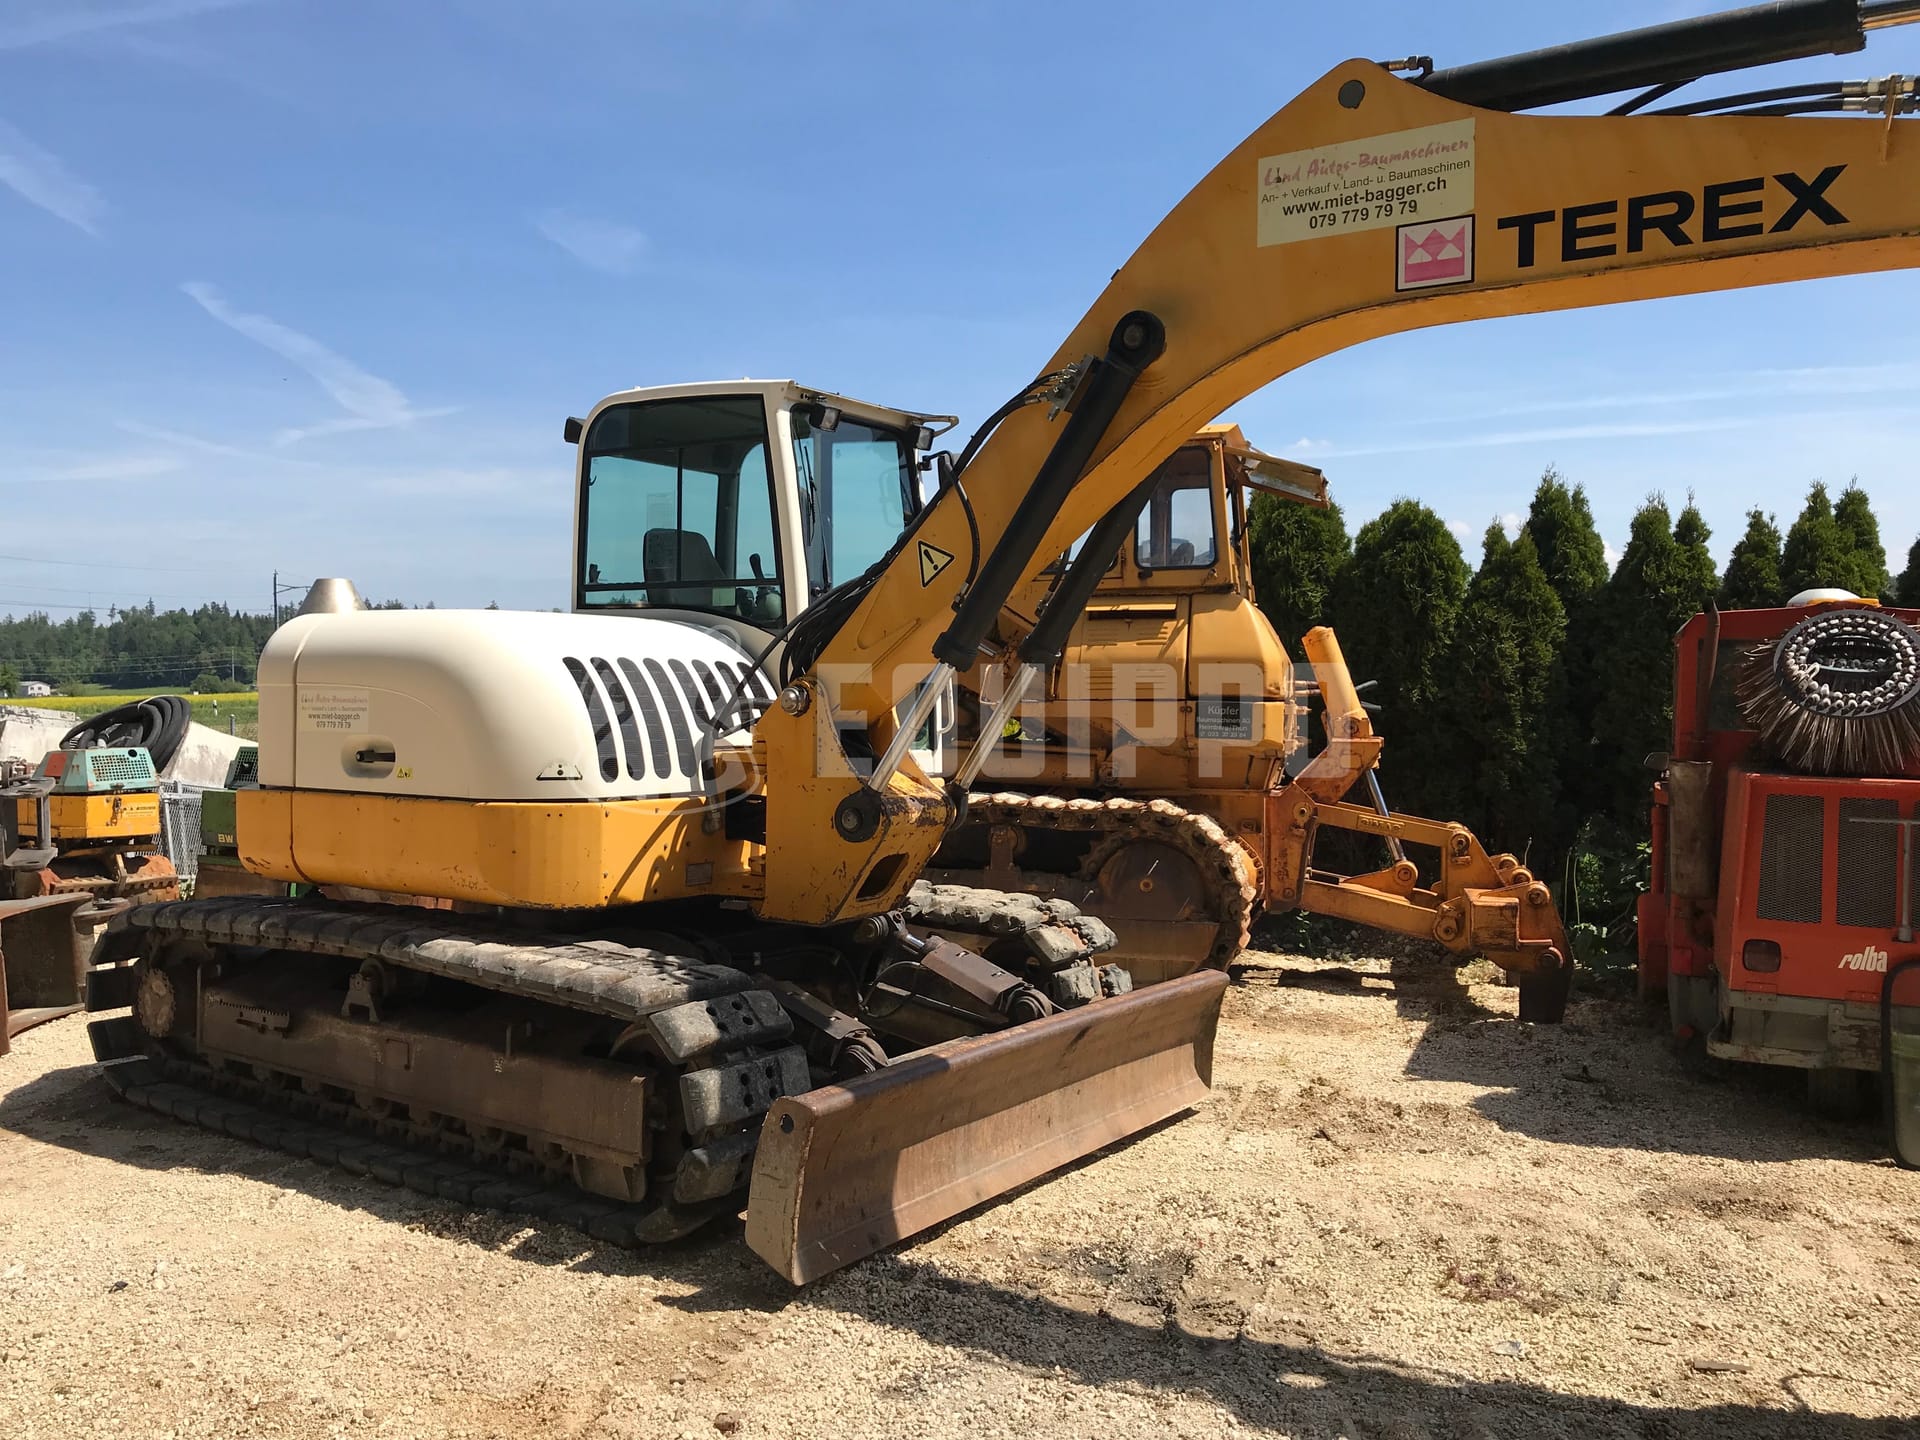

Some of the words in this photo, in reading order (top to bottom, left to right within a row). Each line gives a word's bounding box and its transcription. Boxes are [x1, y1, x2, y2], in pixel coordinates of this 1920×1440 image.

[1262, 194, 1279, 204] An-
[1292, 182, 1330, 199] Verkauf
[1343, 176, 1373, 190] Land-
[1377, 175, 1386, 184] u.
[1389, 160, 1470, 182] Baumaschinen
[1283, 177, 1447, 216] www.miet-bagger.ch
[1310, 212, 1337, 229] 079
[1342, 207, 1369, 224] 779
[1375, 203, 1393, 219] 79
[1399, 199, 1417, 215] 79
[1497, 164, 1850, 268] TEREX
[1208, 704, 1239, 715] Küpfer
[218, 833, 233, 843] BW
[1838, 945, 1888, 972] rolba
